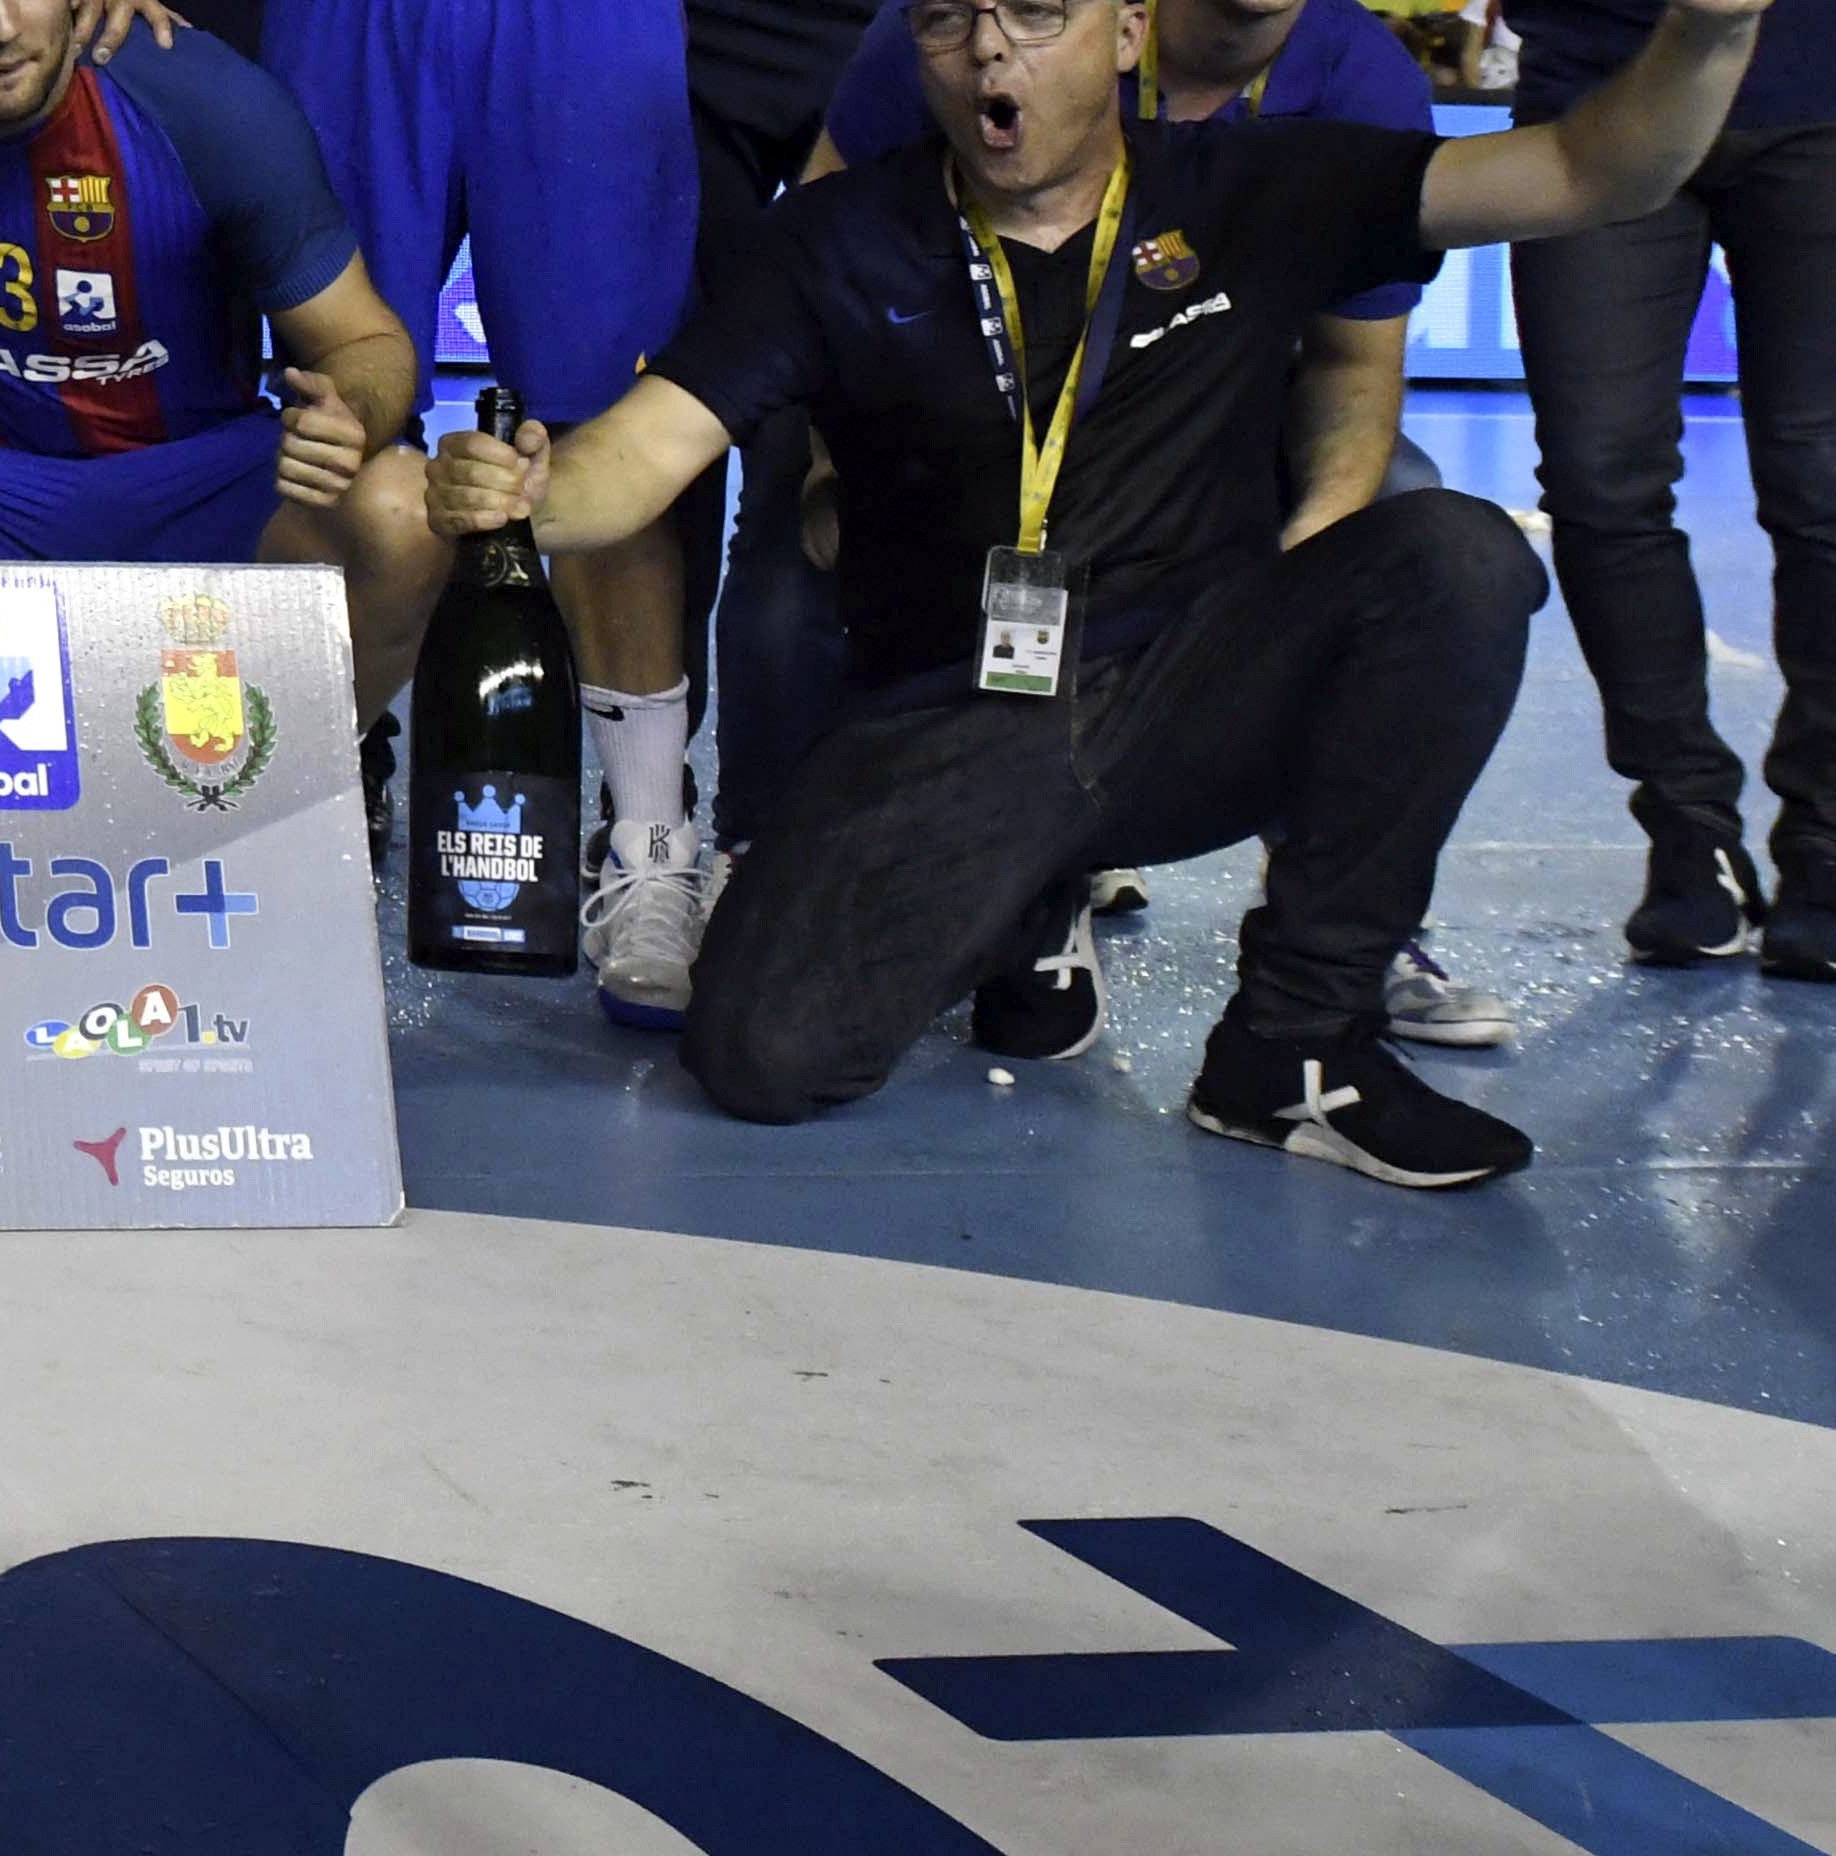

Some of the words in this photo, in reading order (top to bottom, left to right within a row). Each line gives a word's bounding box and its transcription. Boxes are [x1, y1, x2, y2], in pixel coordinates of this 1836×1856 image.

[63, 319, 117, 333] asobal
[437, 830, 467, 853] ELS
[470, 832, 517, 857] REIS
[520, 834, 544, 859] DE
[441, 854, 539, 882] L'HANDBOL
[139, 1125, 314, 1162] PlusUltra
[143, 1165, 235, 1190] Seguros
